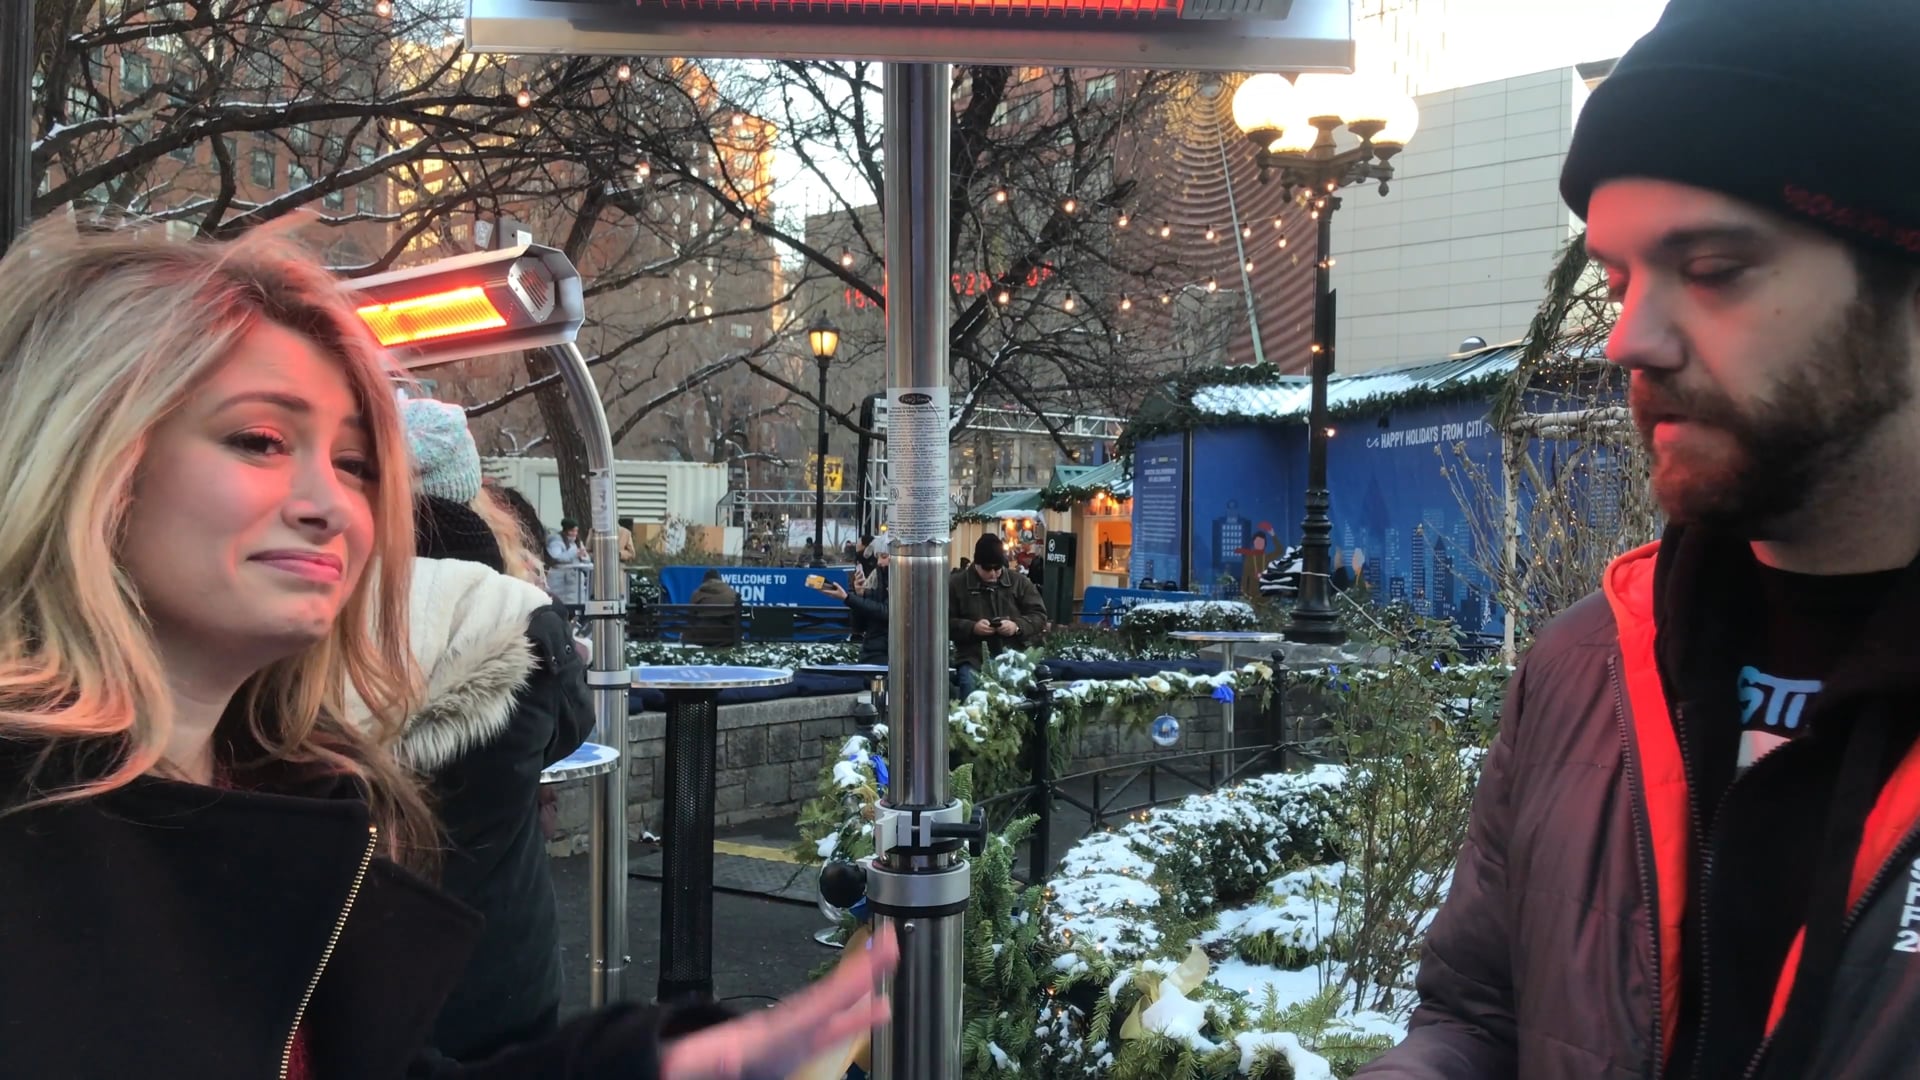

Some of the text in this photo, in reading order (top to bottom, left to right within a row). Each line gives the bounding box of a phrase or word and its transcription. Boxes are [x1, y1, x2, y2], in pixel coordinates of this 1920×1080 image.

[1381, 420, 1482, 448] HAPPY HOLIDAYS FROM CITI
[1047, 553, 1066, 563] NO PETS
[721, 574, 787, 584] WELCOME TO
